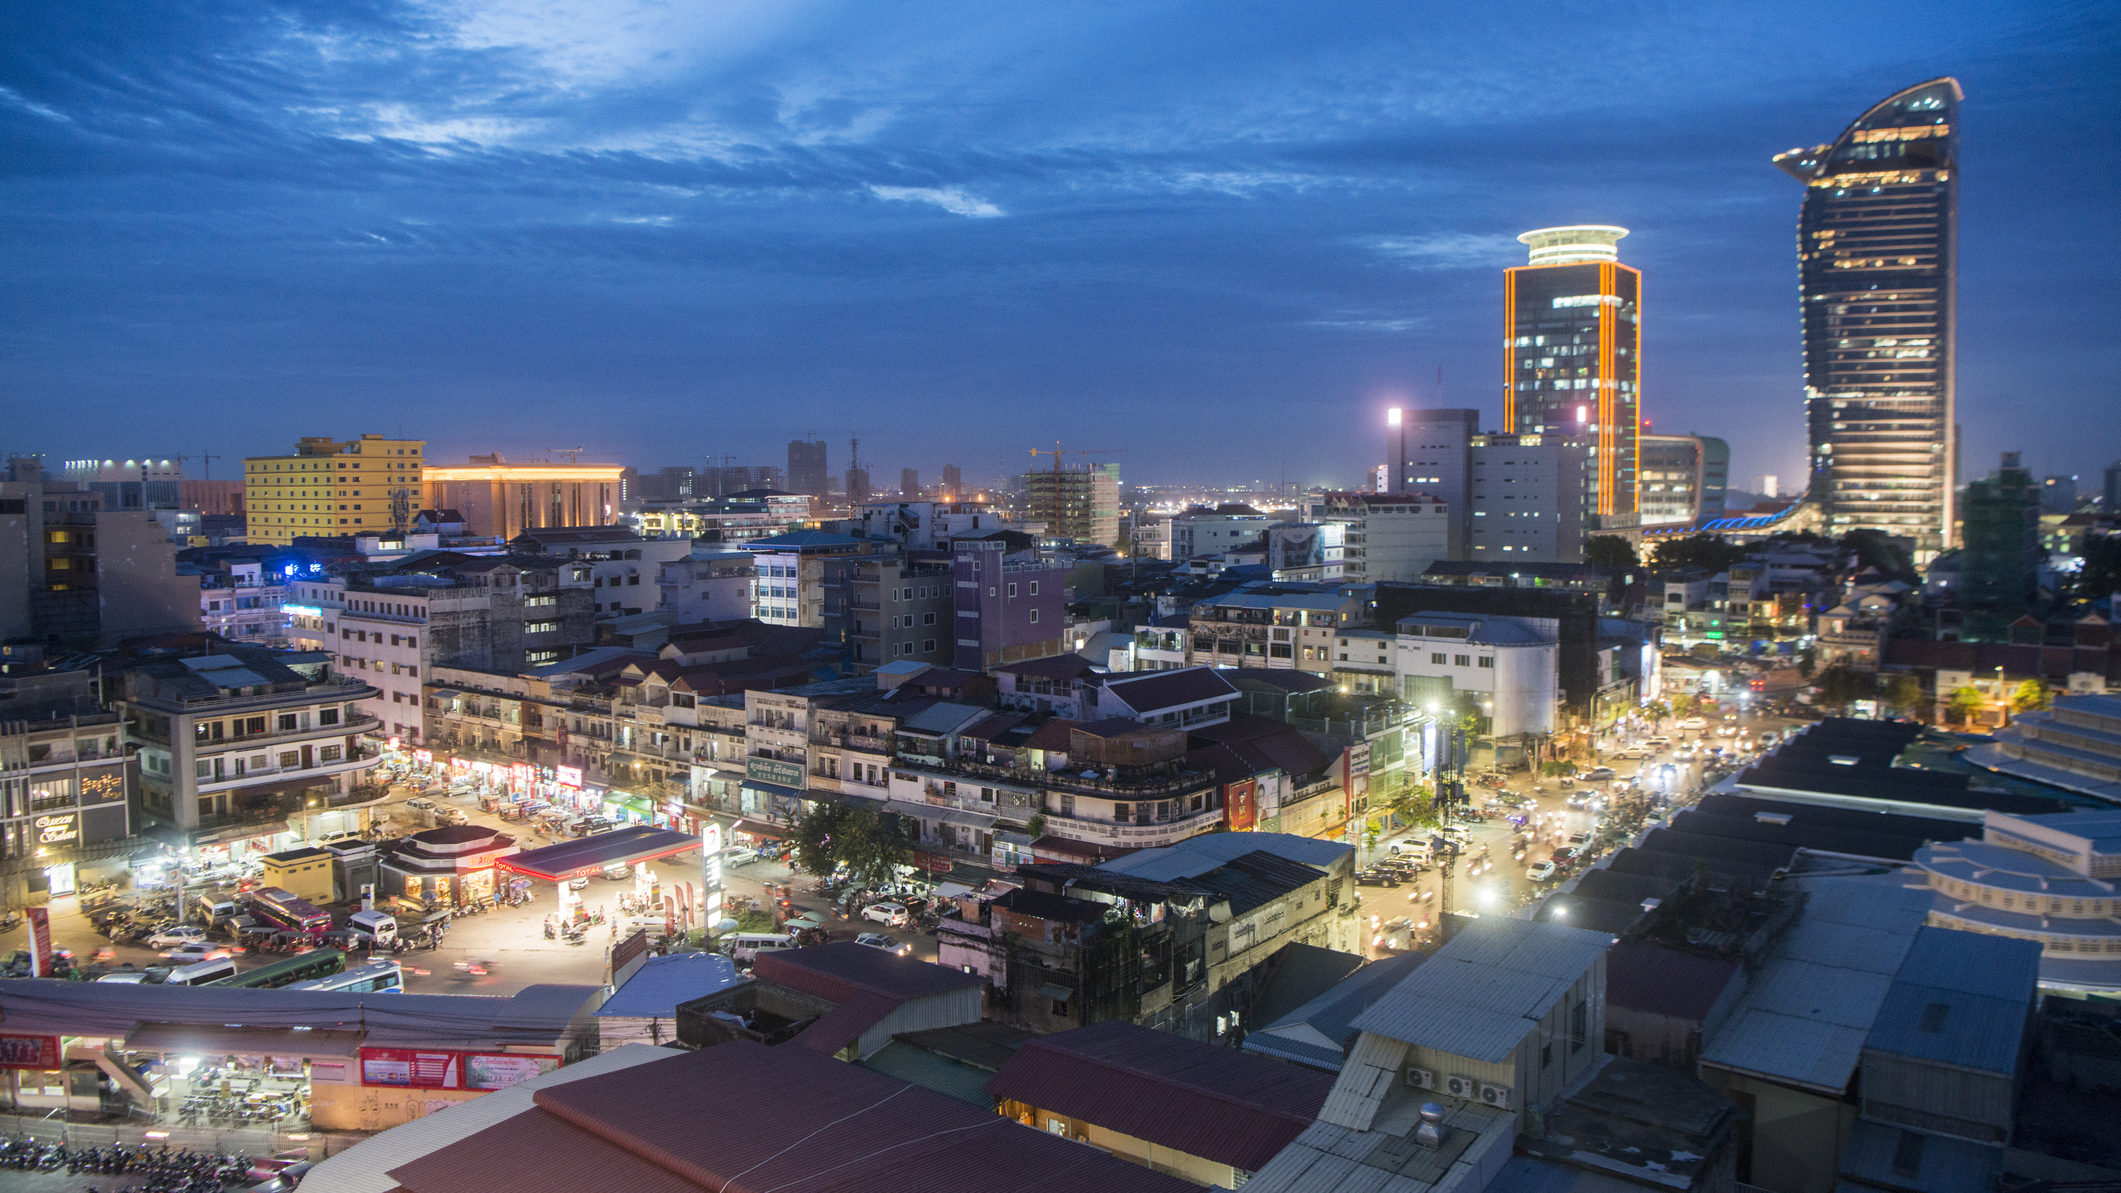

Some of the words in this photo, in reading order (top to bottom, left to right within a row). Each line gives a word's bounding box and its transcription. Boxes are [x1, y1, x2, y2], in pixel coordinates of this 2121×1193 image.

[36, 815, 75, 828] Queen
[40, 830, 77, 843] Salon
[496, 861, 514, 872] TOTAL
[575, 866, 602, 877] TOTAL
